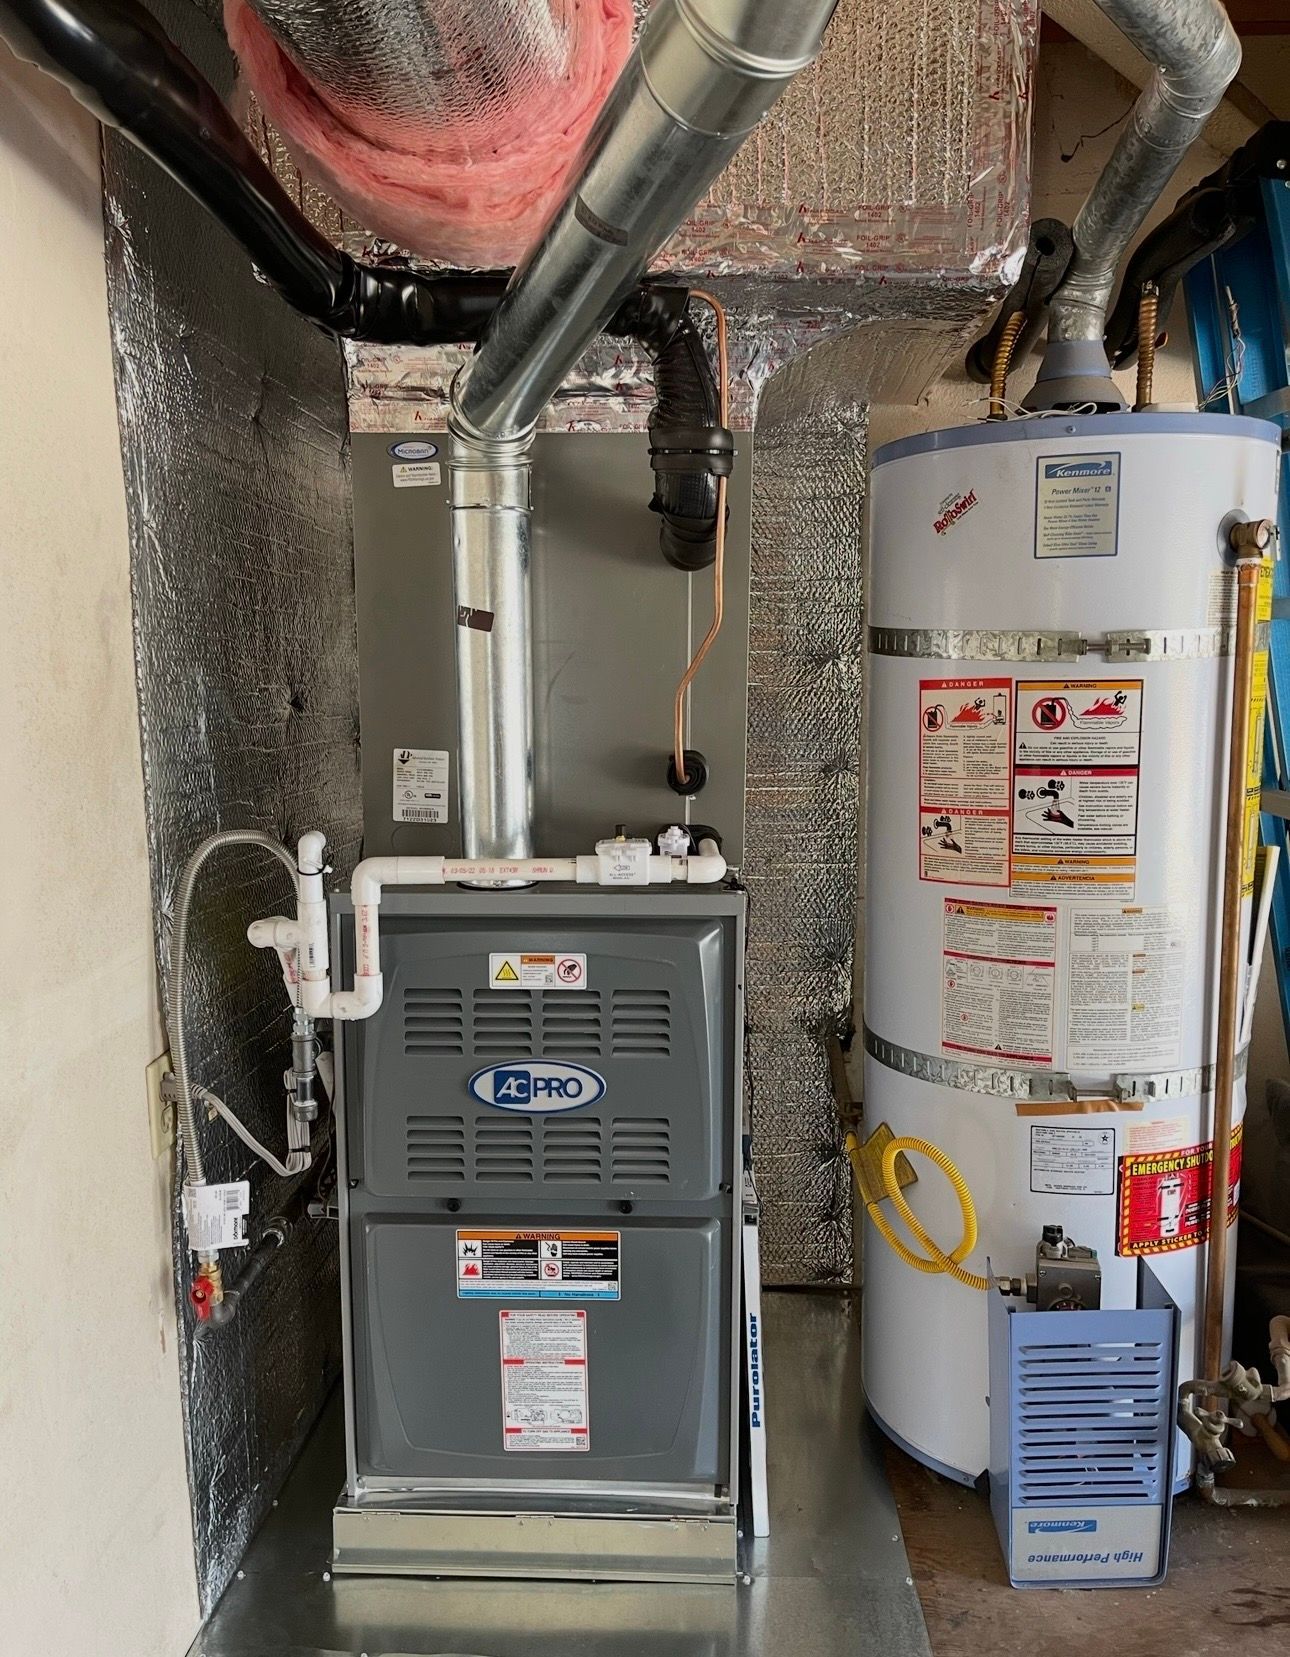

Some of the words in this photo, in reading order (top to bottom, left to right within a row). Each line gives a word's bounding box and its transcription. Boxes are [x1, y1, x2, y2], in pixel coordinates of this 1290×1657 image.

[1056, 467, 1111, 478] Kenmore
[1180, 1148, 1195, 1157] FOR
[1132, 1160, 1185, 1175] EMERGENCY
[1132, 1239, 1160, 1249] APPLY
[1161, 1233, 1192, 1245] STICKER
[749, 1313, 760, 1427] Purolator
[1030, 1520, 1086, 1528] Kenmore
[1028, 1552, 1110, 1564] Performance
[1113, 1550, 1144, 1563] High
